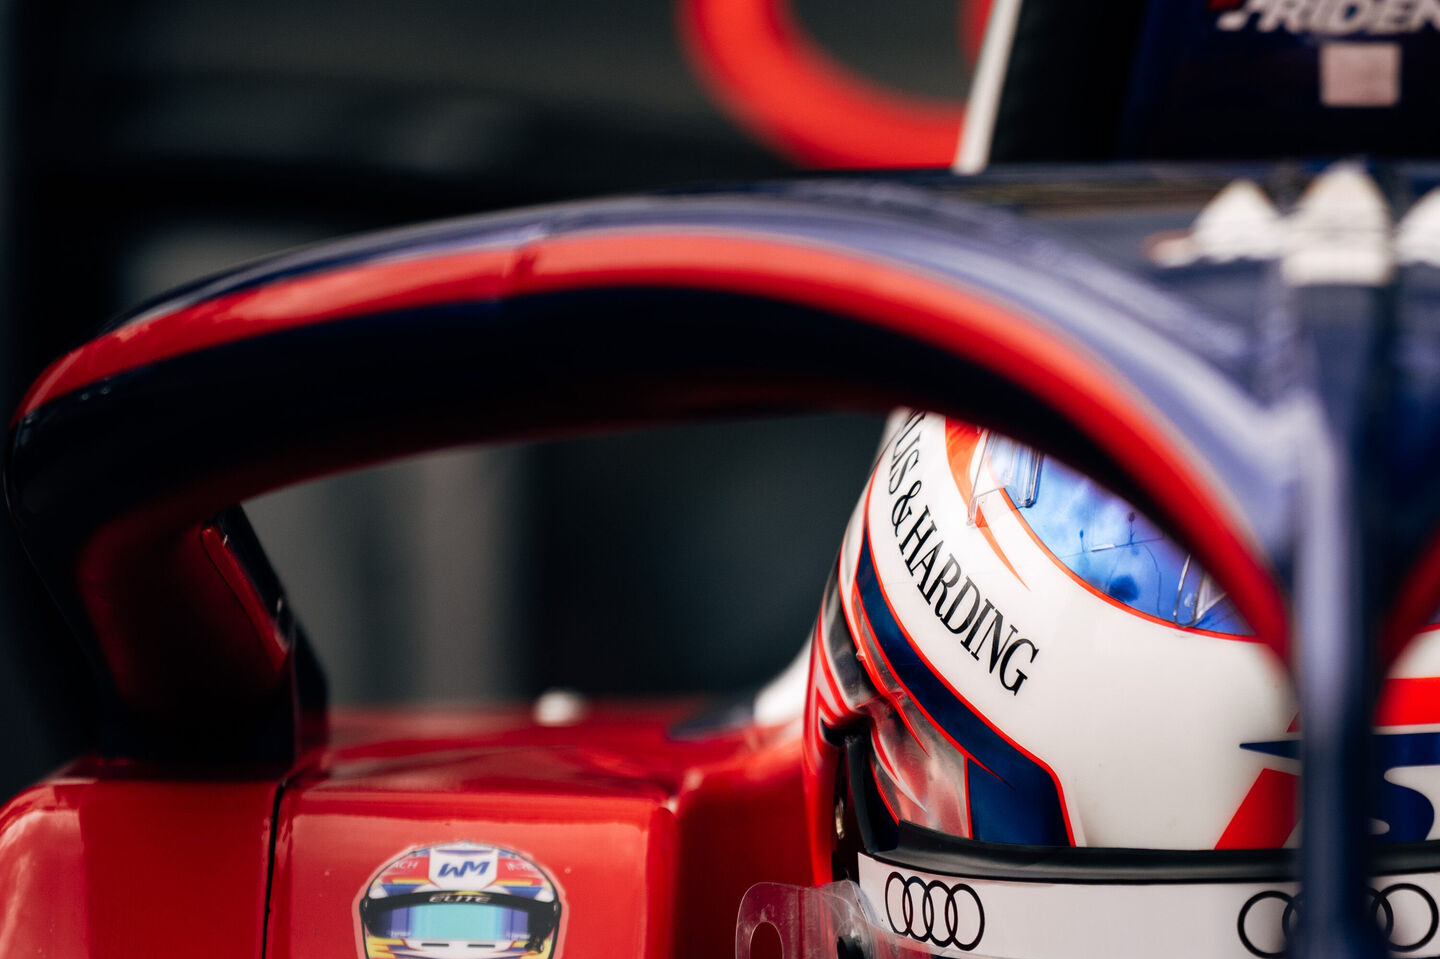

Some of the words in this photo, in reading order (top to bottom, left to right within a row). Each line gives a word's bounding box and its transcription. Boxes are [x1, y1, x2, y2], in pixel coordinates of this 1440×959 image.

[889, 408, 926, 495] LIS
[890, 480, 922, 538] &
[899, 505, 1039, 696] HARDING
[429, 894, 491, 903] ELITE
